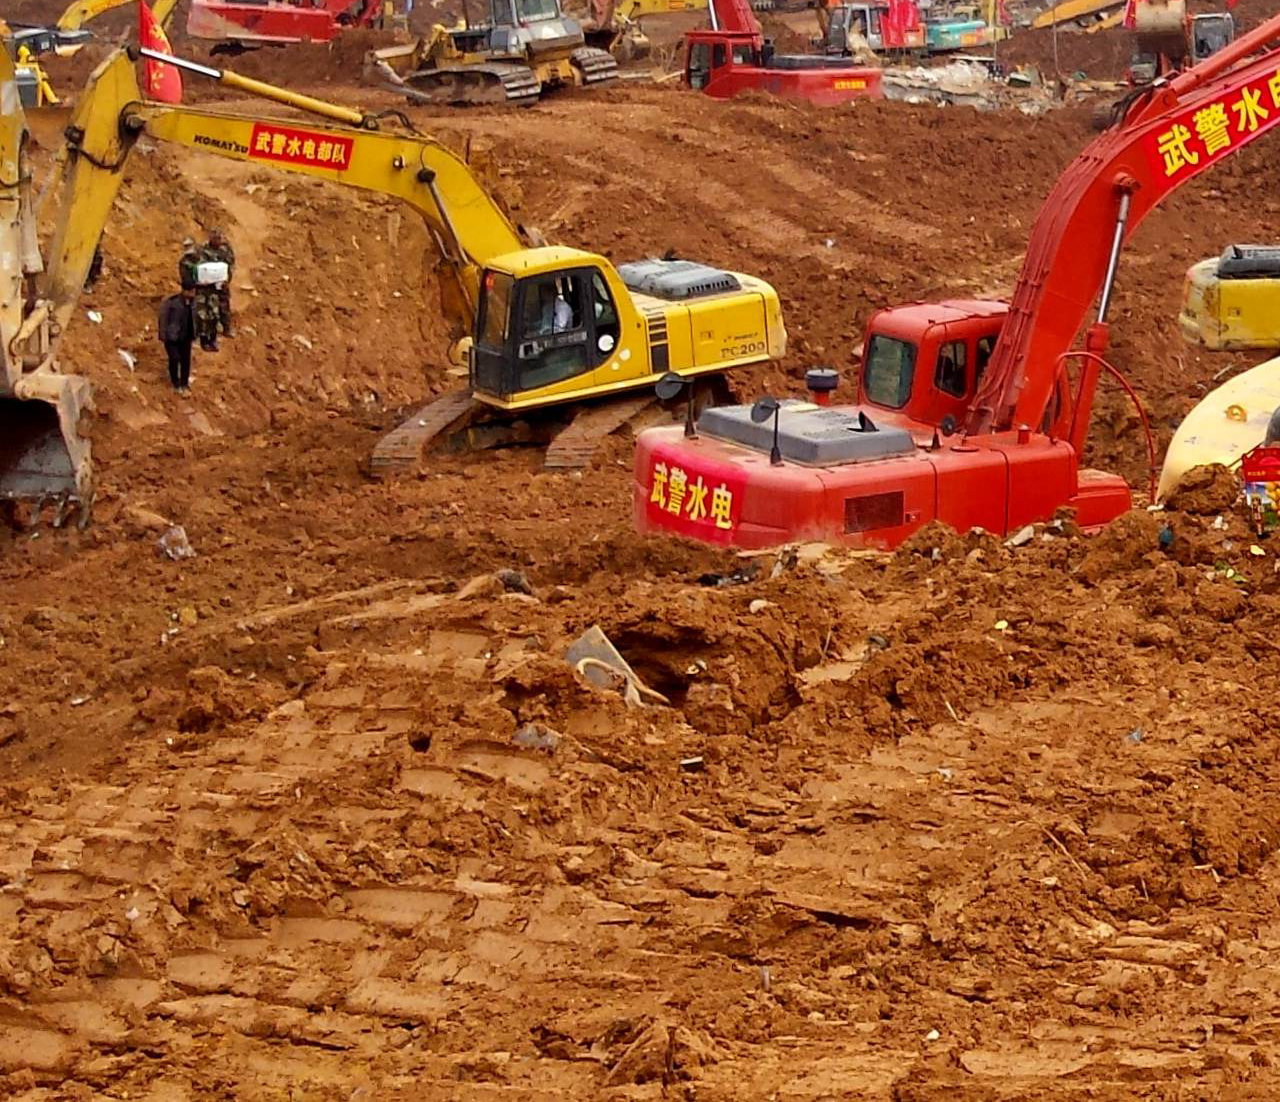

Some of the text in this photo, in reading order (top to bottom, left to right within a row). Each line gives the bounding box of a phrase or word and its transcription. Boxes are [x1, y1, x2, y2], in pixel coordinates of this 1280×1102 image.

[194, 134, 249, 155] KOMATSU
[255, 130, 346, 165] 武警水电部队
[721, 341, 766, 358] PC200
[650, 461, 734, 530] 武警水电
